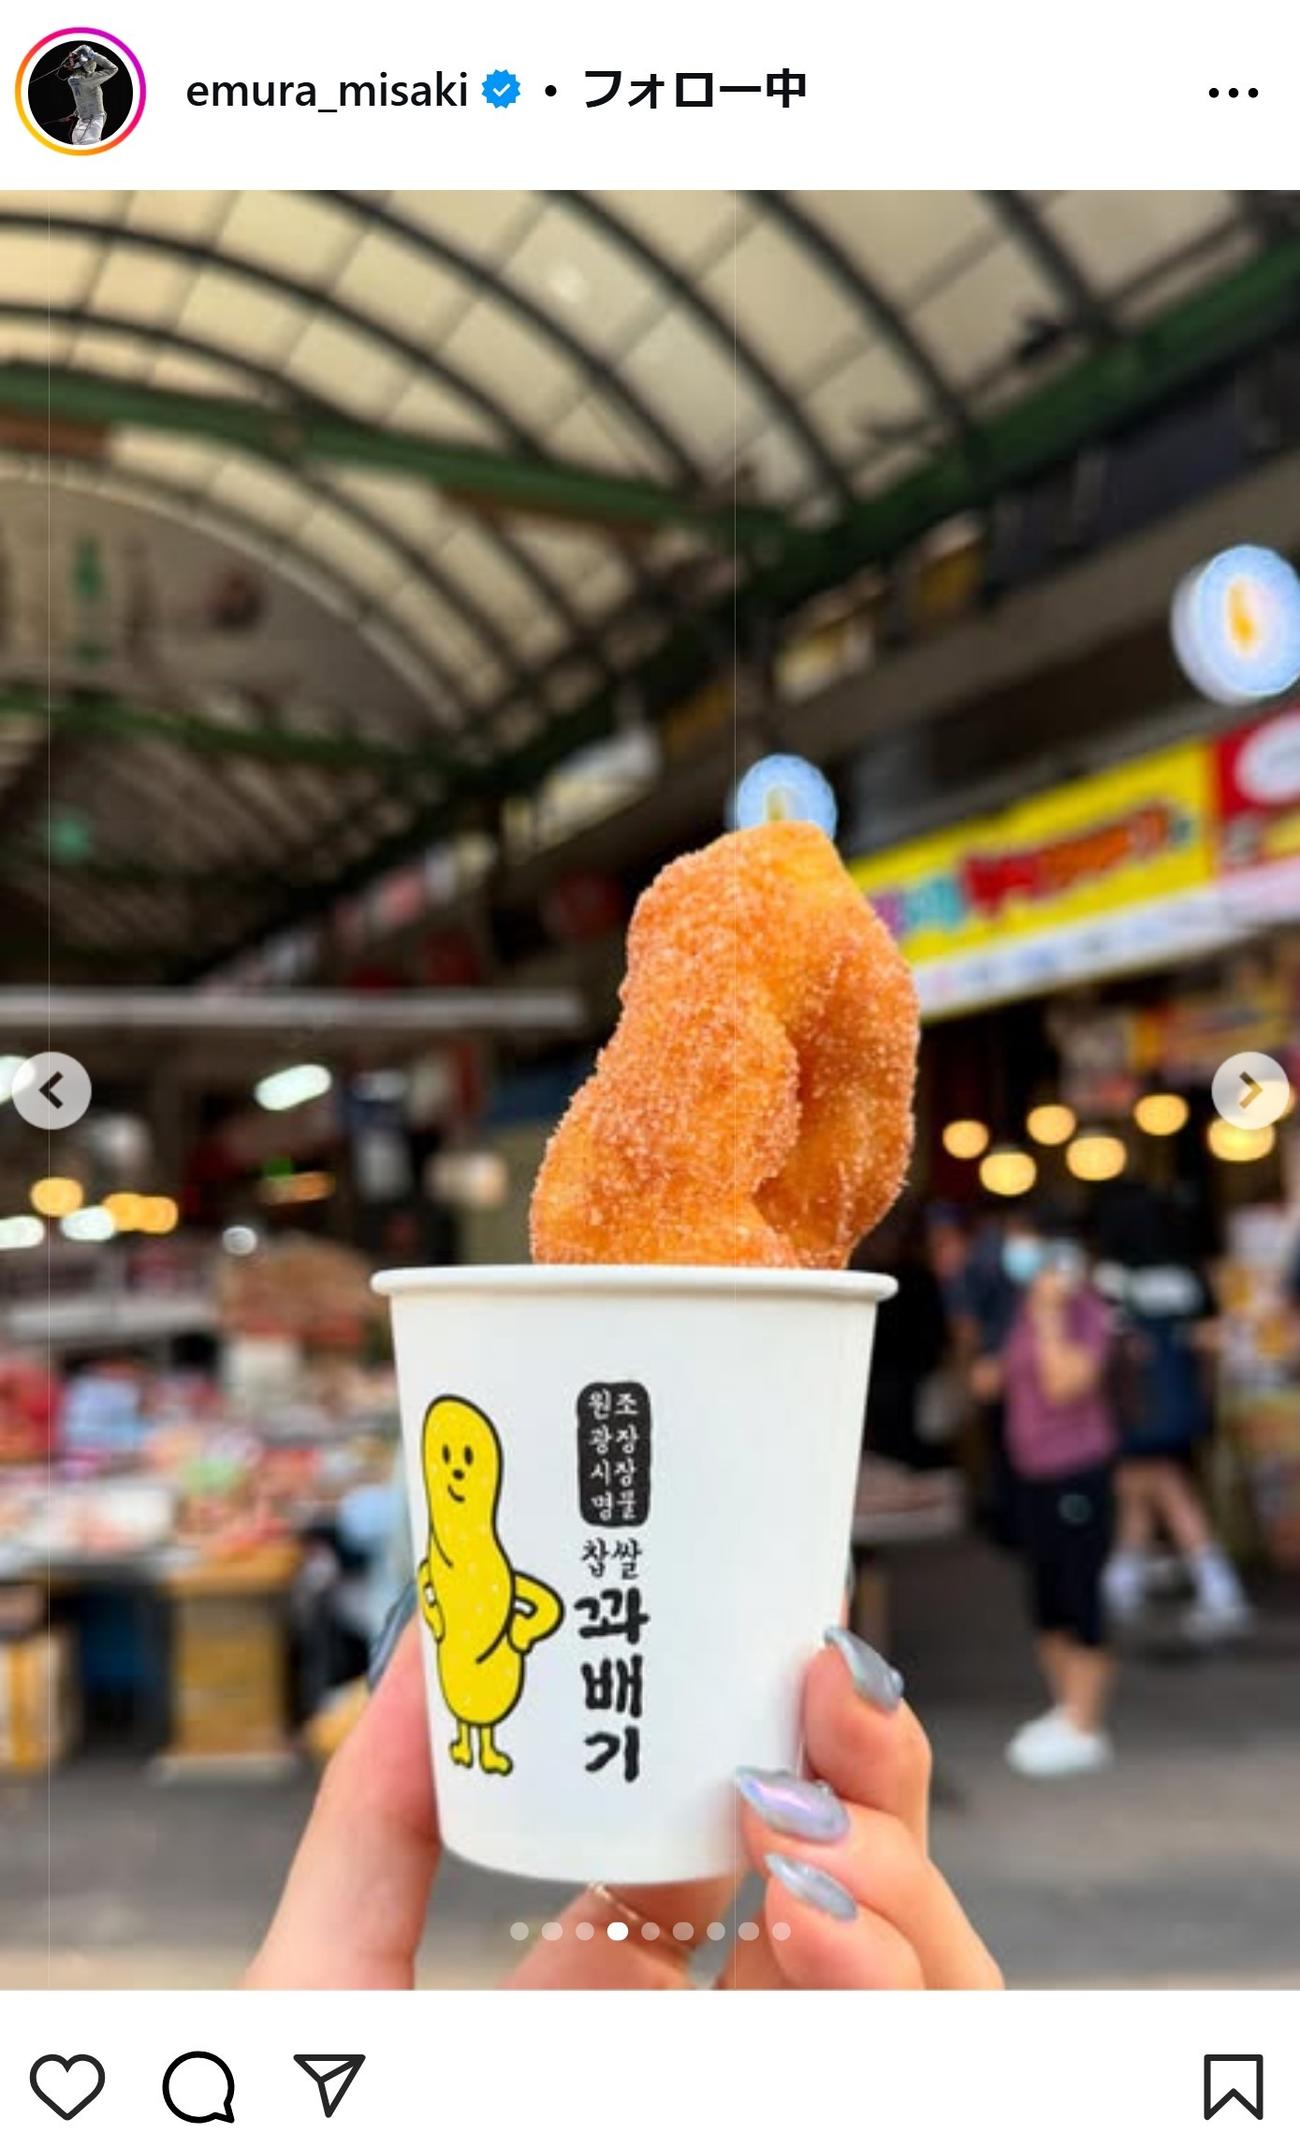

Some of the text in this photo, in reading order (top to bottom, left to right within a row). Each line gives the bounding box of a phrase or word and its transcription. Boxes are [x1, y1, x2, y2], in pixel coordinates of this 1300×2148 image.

[588, 1388, 638, 1420] 원조
[589, 1423, 638, 1455] 광장
[589, 1457, 637, 1487] 시장
[591, 1489, 636, 1521] 명물
[581, 1537, 642, 1580] 찹쌀
[573, 1587, 650, 1783] 꽈배기
